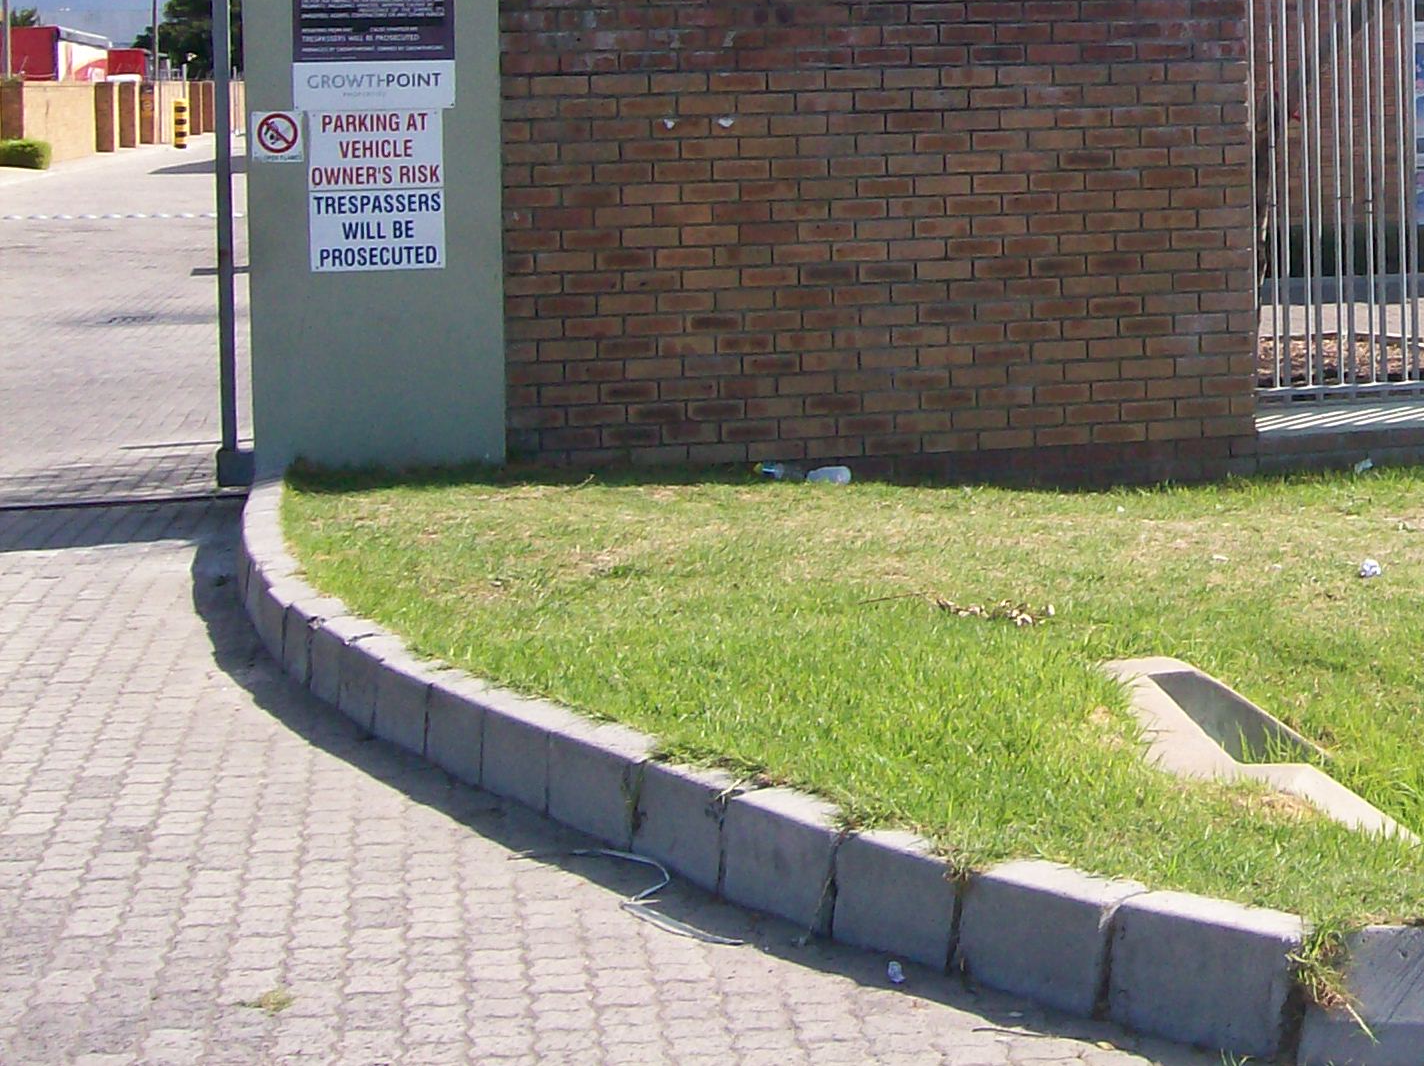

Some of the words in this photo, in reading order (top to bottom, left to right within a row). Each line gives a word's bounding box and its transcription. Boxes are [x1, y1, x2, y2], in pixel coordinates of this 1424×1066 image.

[306, 72, 442, 90] GROWTHPOINT
[321, 113, 401, 134] PARKING
[406, 112, 429, 132] AT
[339, 139, 413, 159] VEHICLE
[311, 165, 393, 186] OWNER'S
[400, 164, 441, 183] RISK
[313, 193, 442, 215] TRESPASSERS
[342, 221, 387, 240] WILL
[392, 220, 415, 239] BE
[319, 245, 438, 268] PROSECUTED
